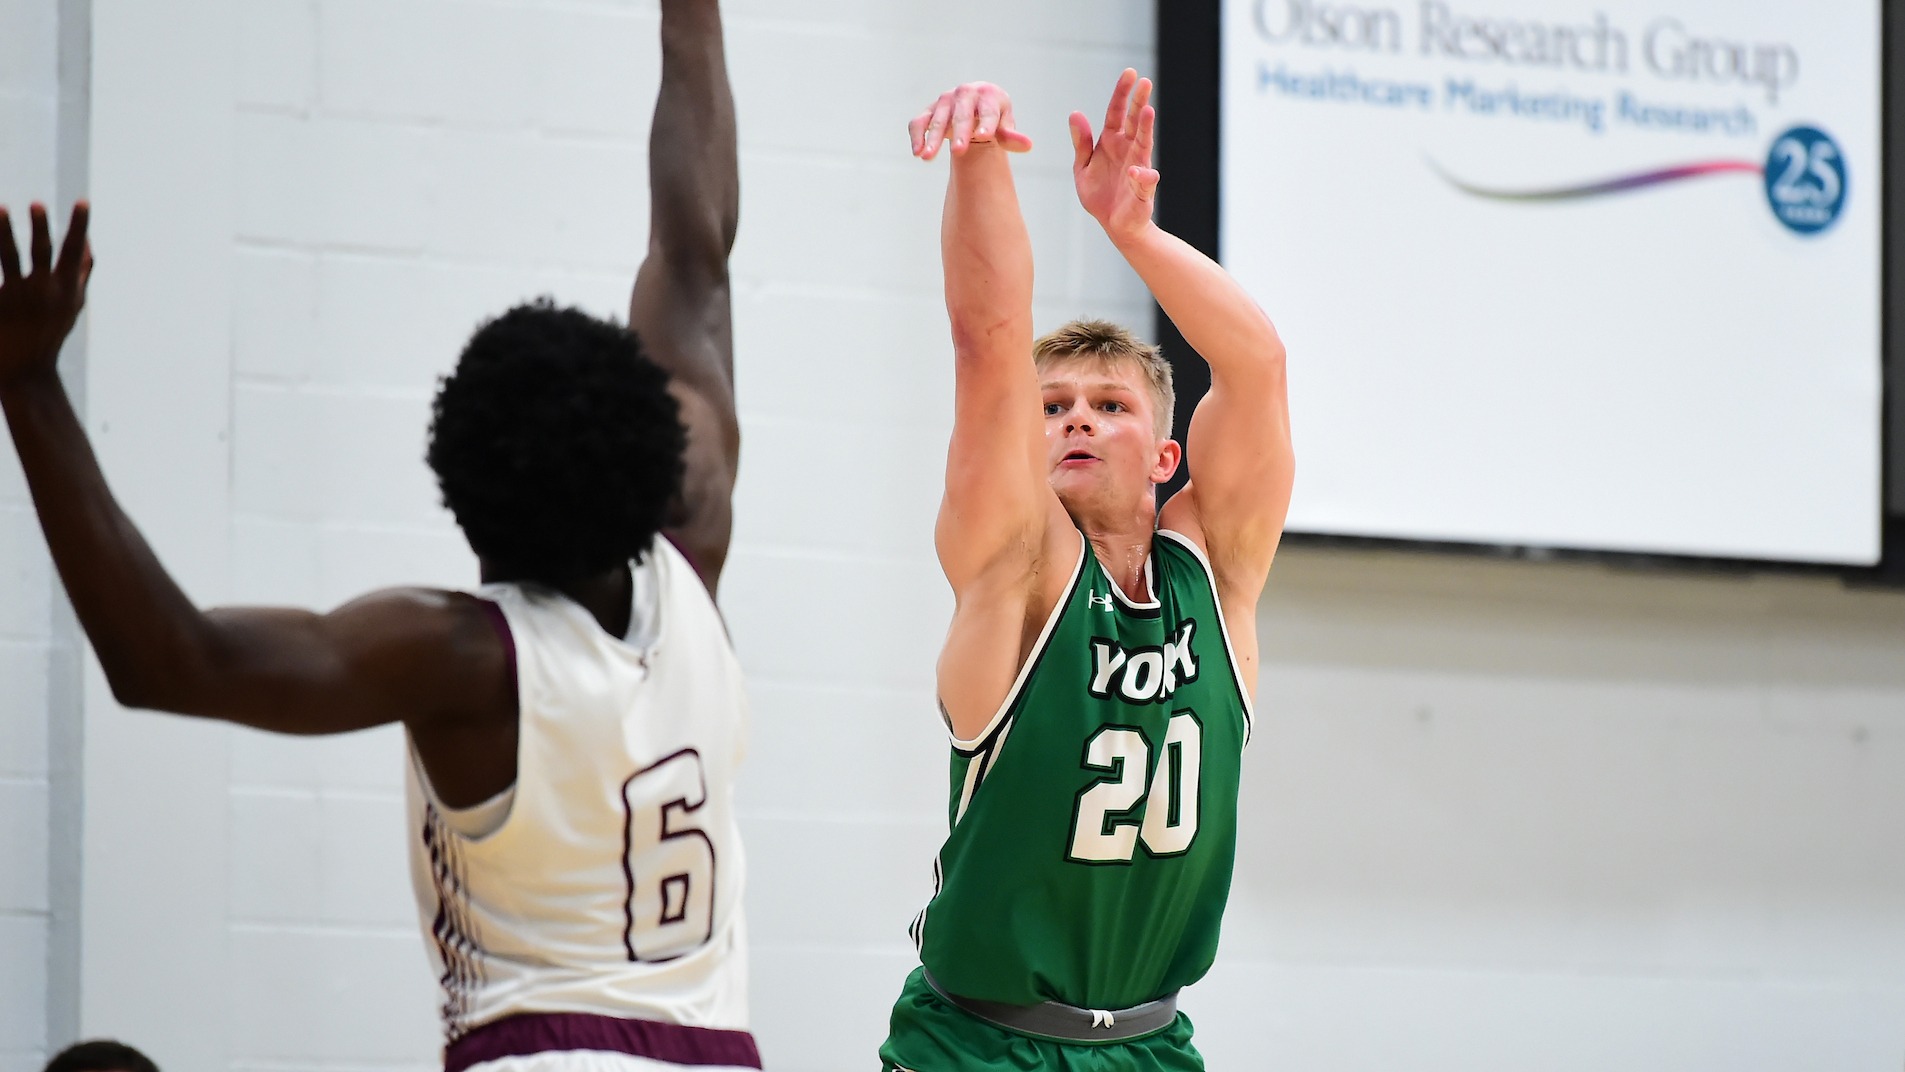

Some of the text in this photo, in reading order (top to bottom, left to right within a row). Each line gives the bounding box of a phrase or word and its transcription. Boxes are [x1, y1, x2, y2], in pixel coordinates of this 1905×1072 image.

[1253, 0, 1799, 105] Olson Research Group
[1256, 62, 1757, 134] Healthcare Marketing Research
[1773, 138, 1841, 207] 25
[1064, 708, 1202, 864] 20
[622, 748, 716, 964] 6
